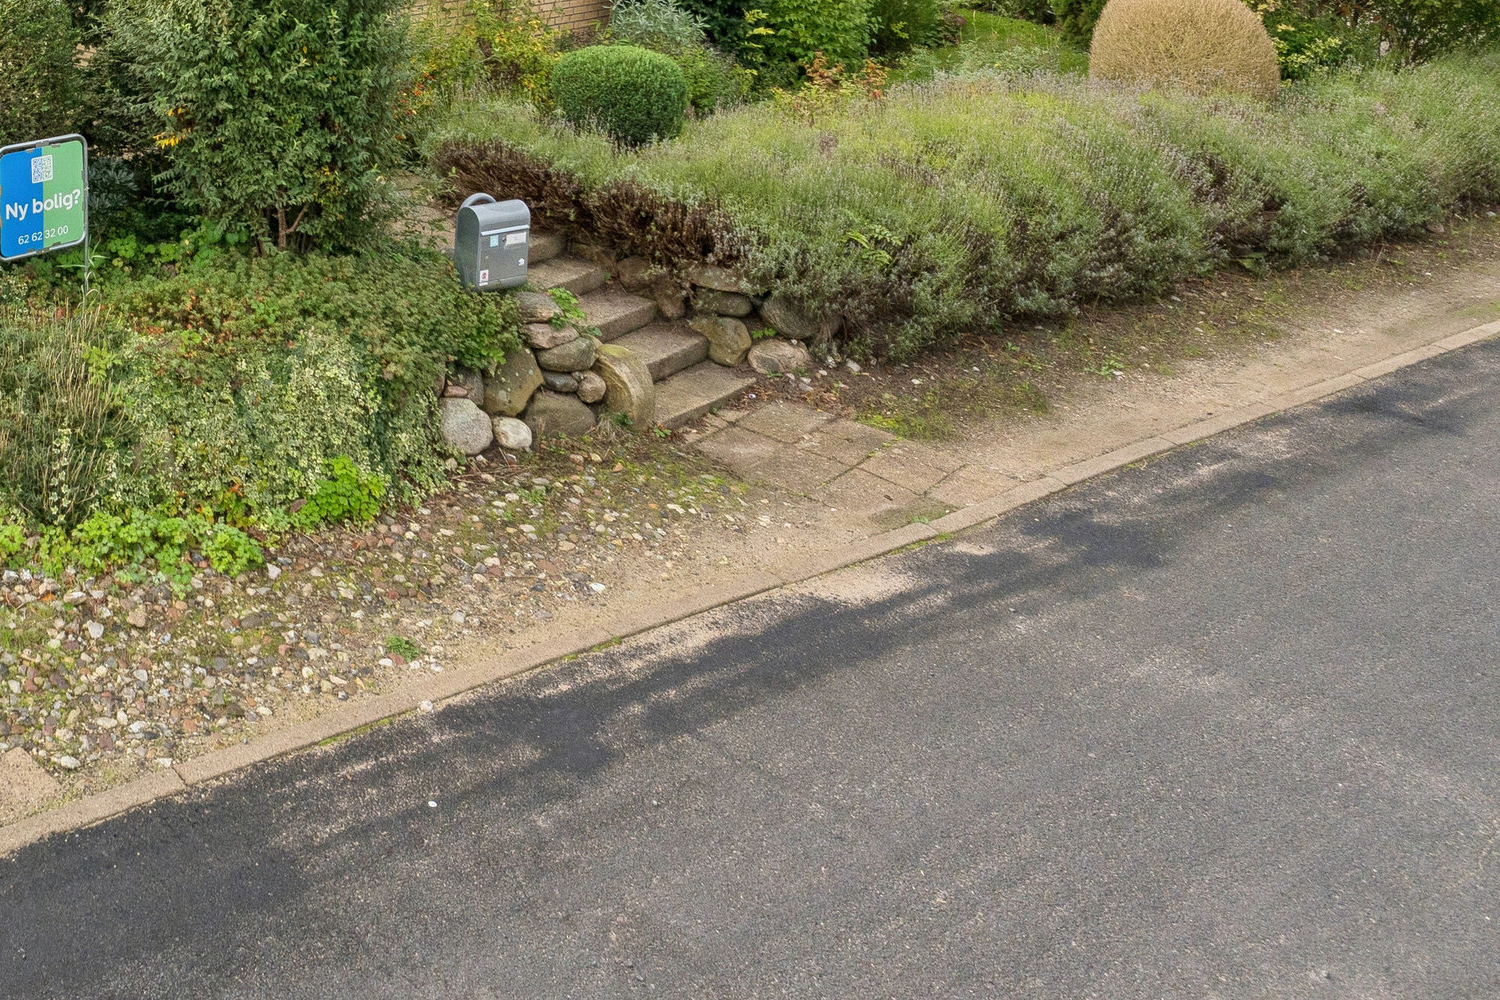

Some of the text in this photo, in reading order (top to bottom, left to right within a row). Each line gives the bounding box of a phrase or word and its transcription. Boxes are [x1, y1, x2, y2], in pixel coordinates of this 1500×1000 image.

[5, 188, 81, 221] Ny bolig?
[18, 225, 69, 245] 62 62 32 00
